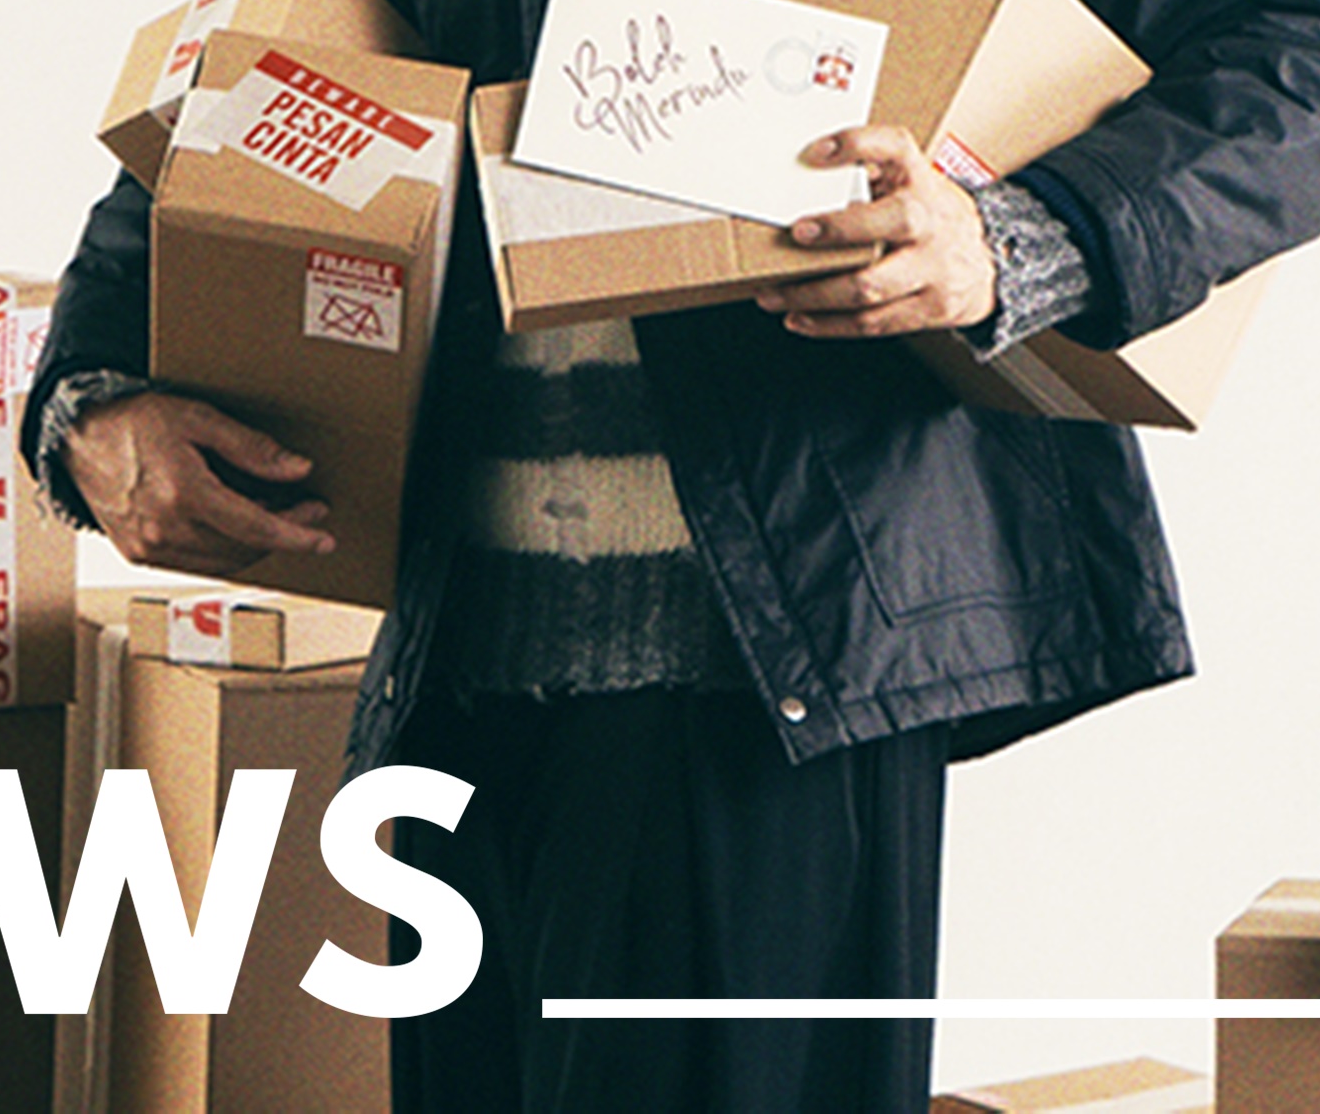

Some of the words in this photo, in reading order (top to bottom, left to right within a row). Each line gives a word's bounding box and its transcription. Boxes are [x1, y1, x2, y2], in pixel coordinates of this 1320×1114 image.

[261, 90, 376, 160] PESAN
[289, 69, 393, 129] BEWARE
[241, 120, 340, 185] CINTA
[312, 253, 395, 283] FRAGILE
